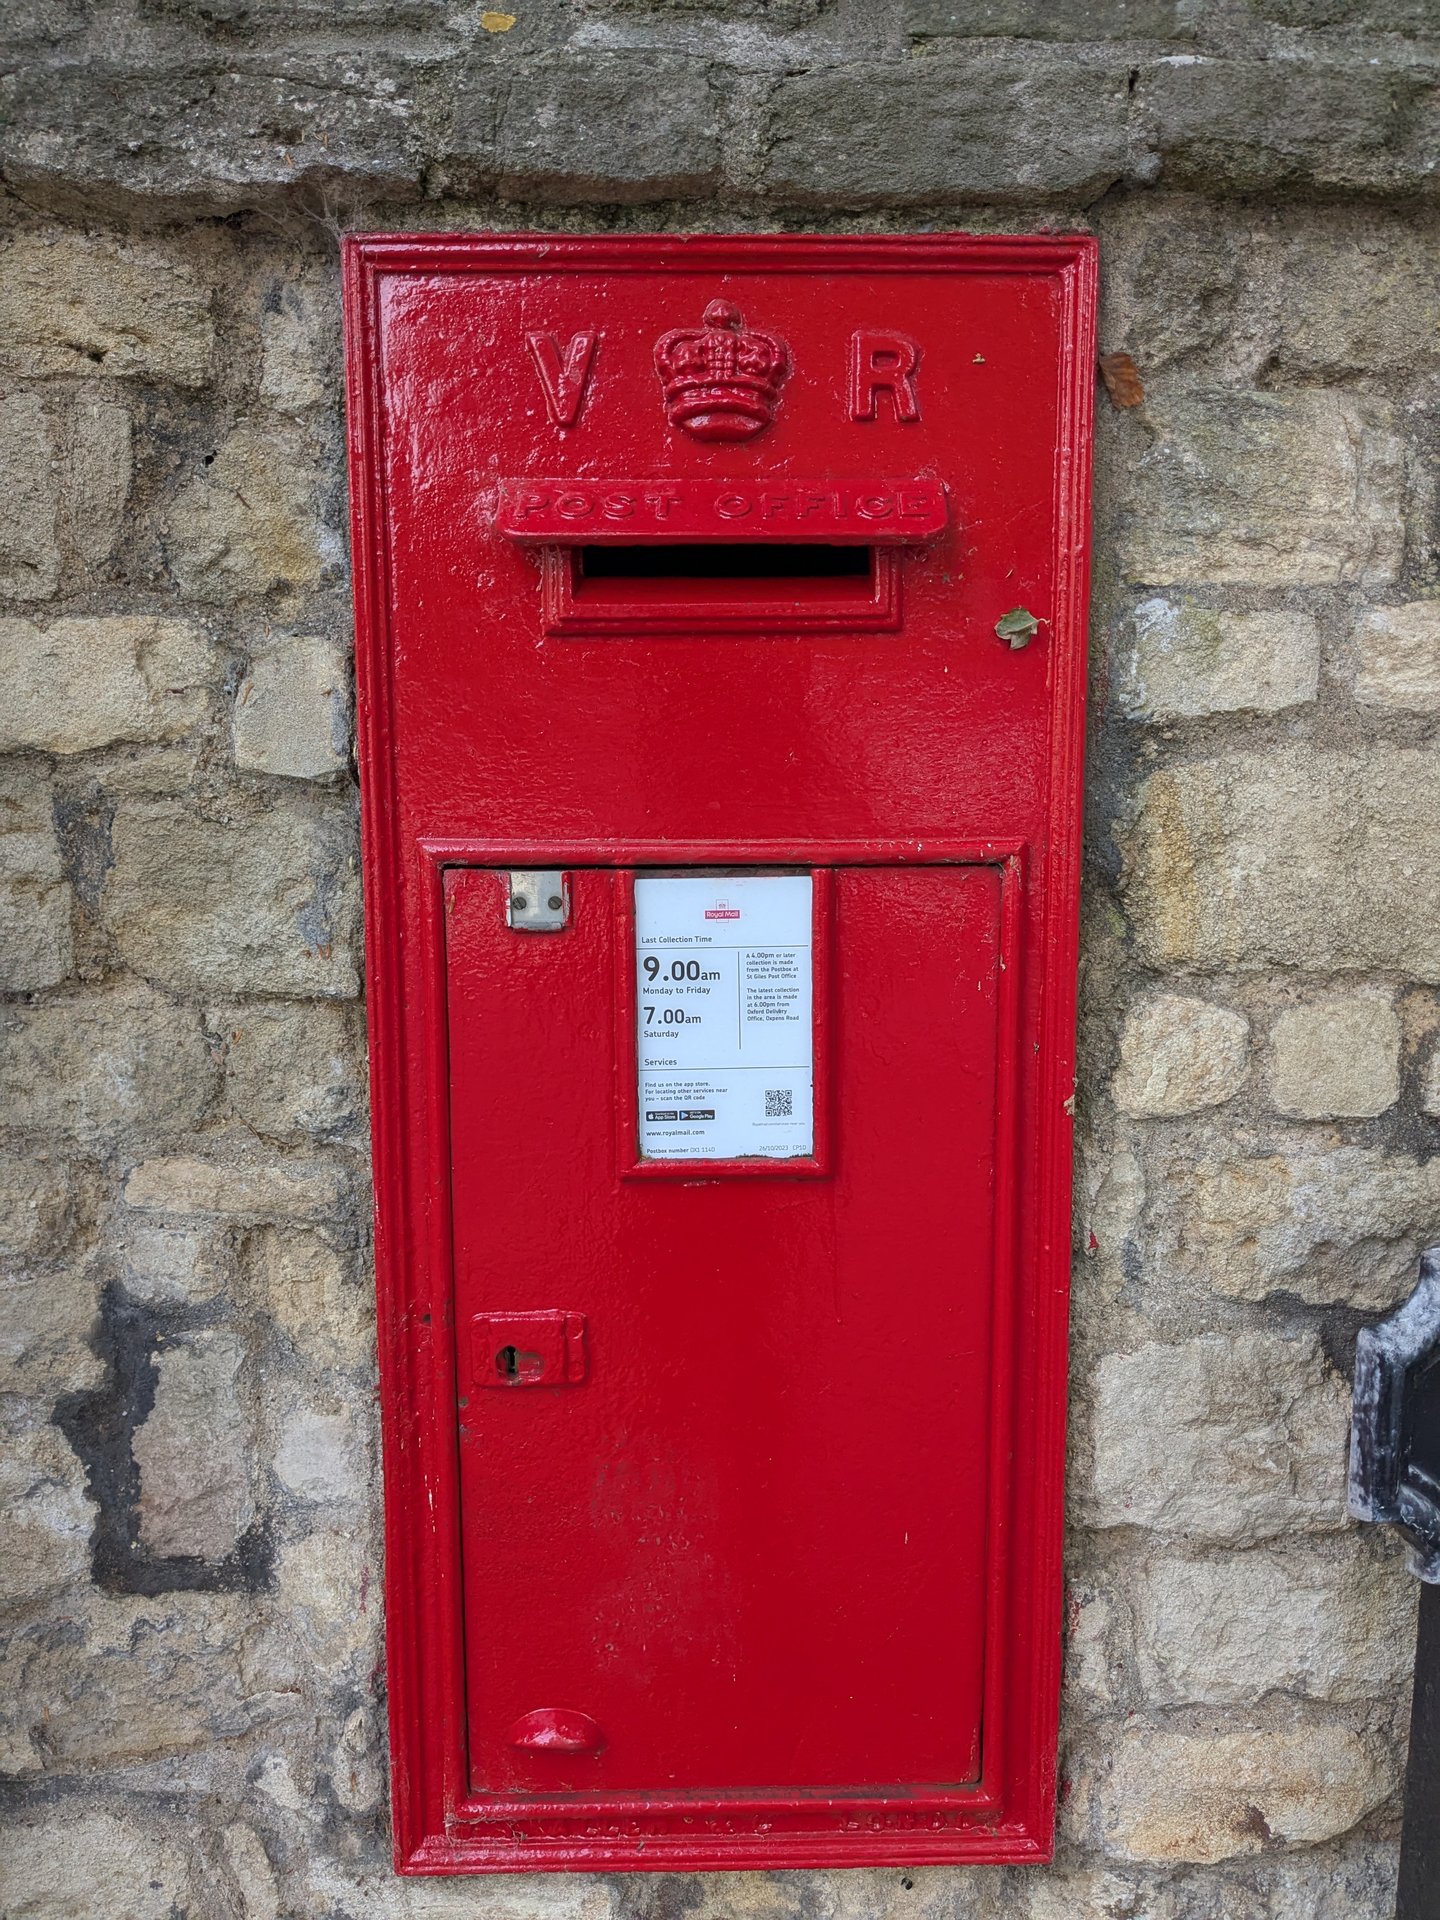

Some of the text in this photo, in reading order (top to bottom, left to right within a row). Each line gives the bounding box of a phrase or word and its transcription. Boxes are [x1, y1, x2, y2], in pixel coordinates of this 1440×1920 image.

[525, 330, 921, 428] V R
[514, 491, 931, 519] POST OFFICE
[706, 911, 724, 919] Royal
[658, 935, 693, 943] Collection
[694, 935, 713, 943] Time
[643, 956, 721, 981] 9.00am
[642, 987, 674, 995] Monday
[686, 986, 711, 995] Friday
[643, 1006, 702, 1024] 7.00am
[643, 1030, 679, 1038] Saturday
[644, 1058, 677, 1066] Services
